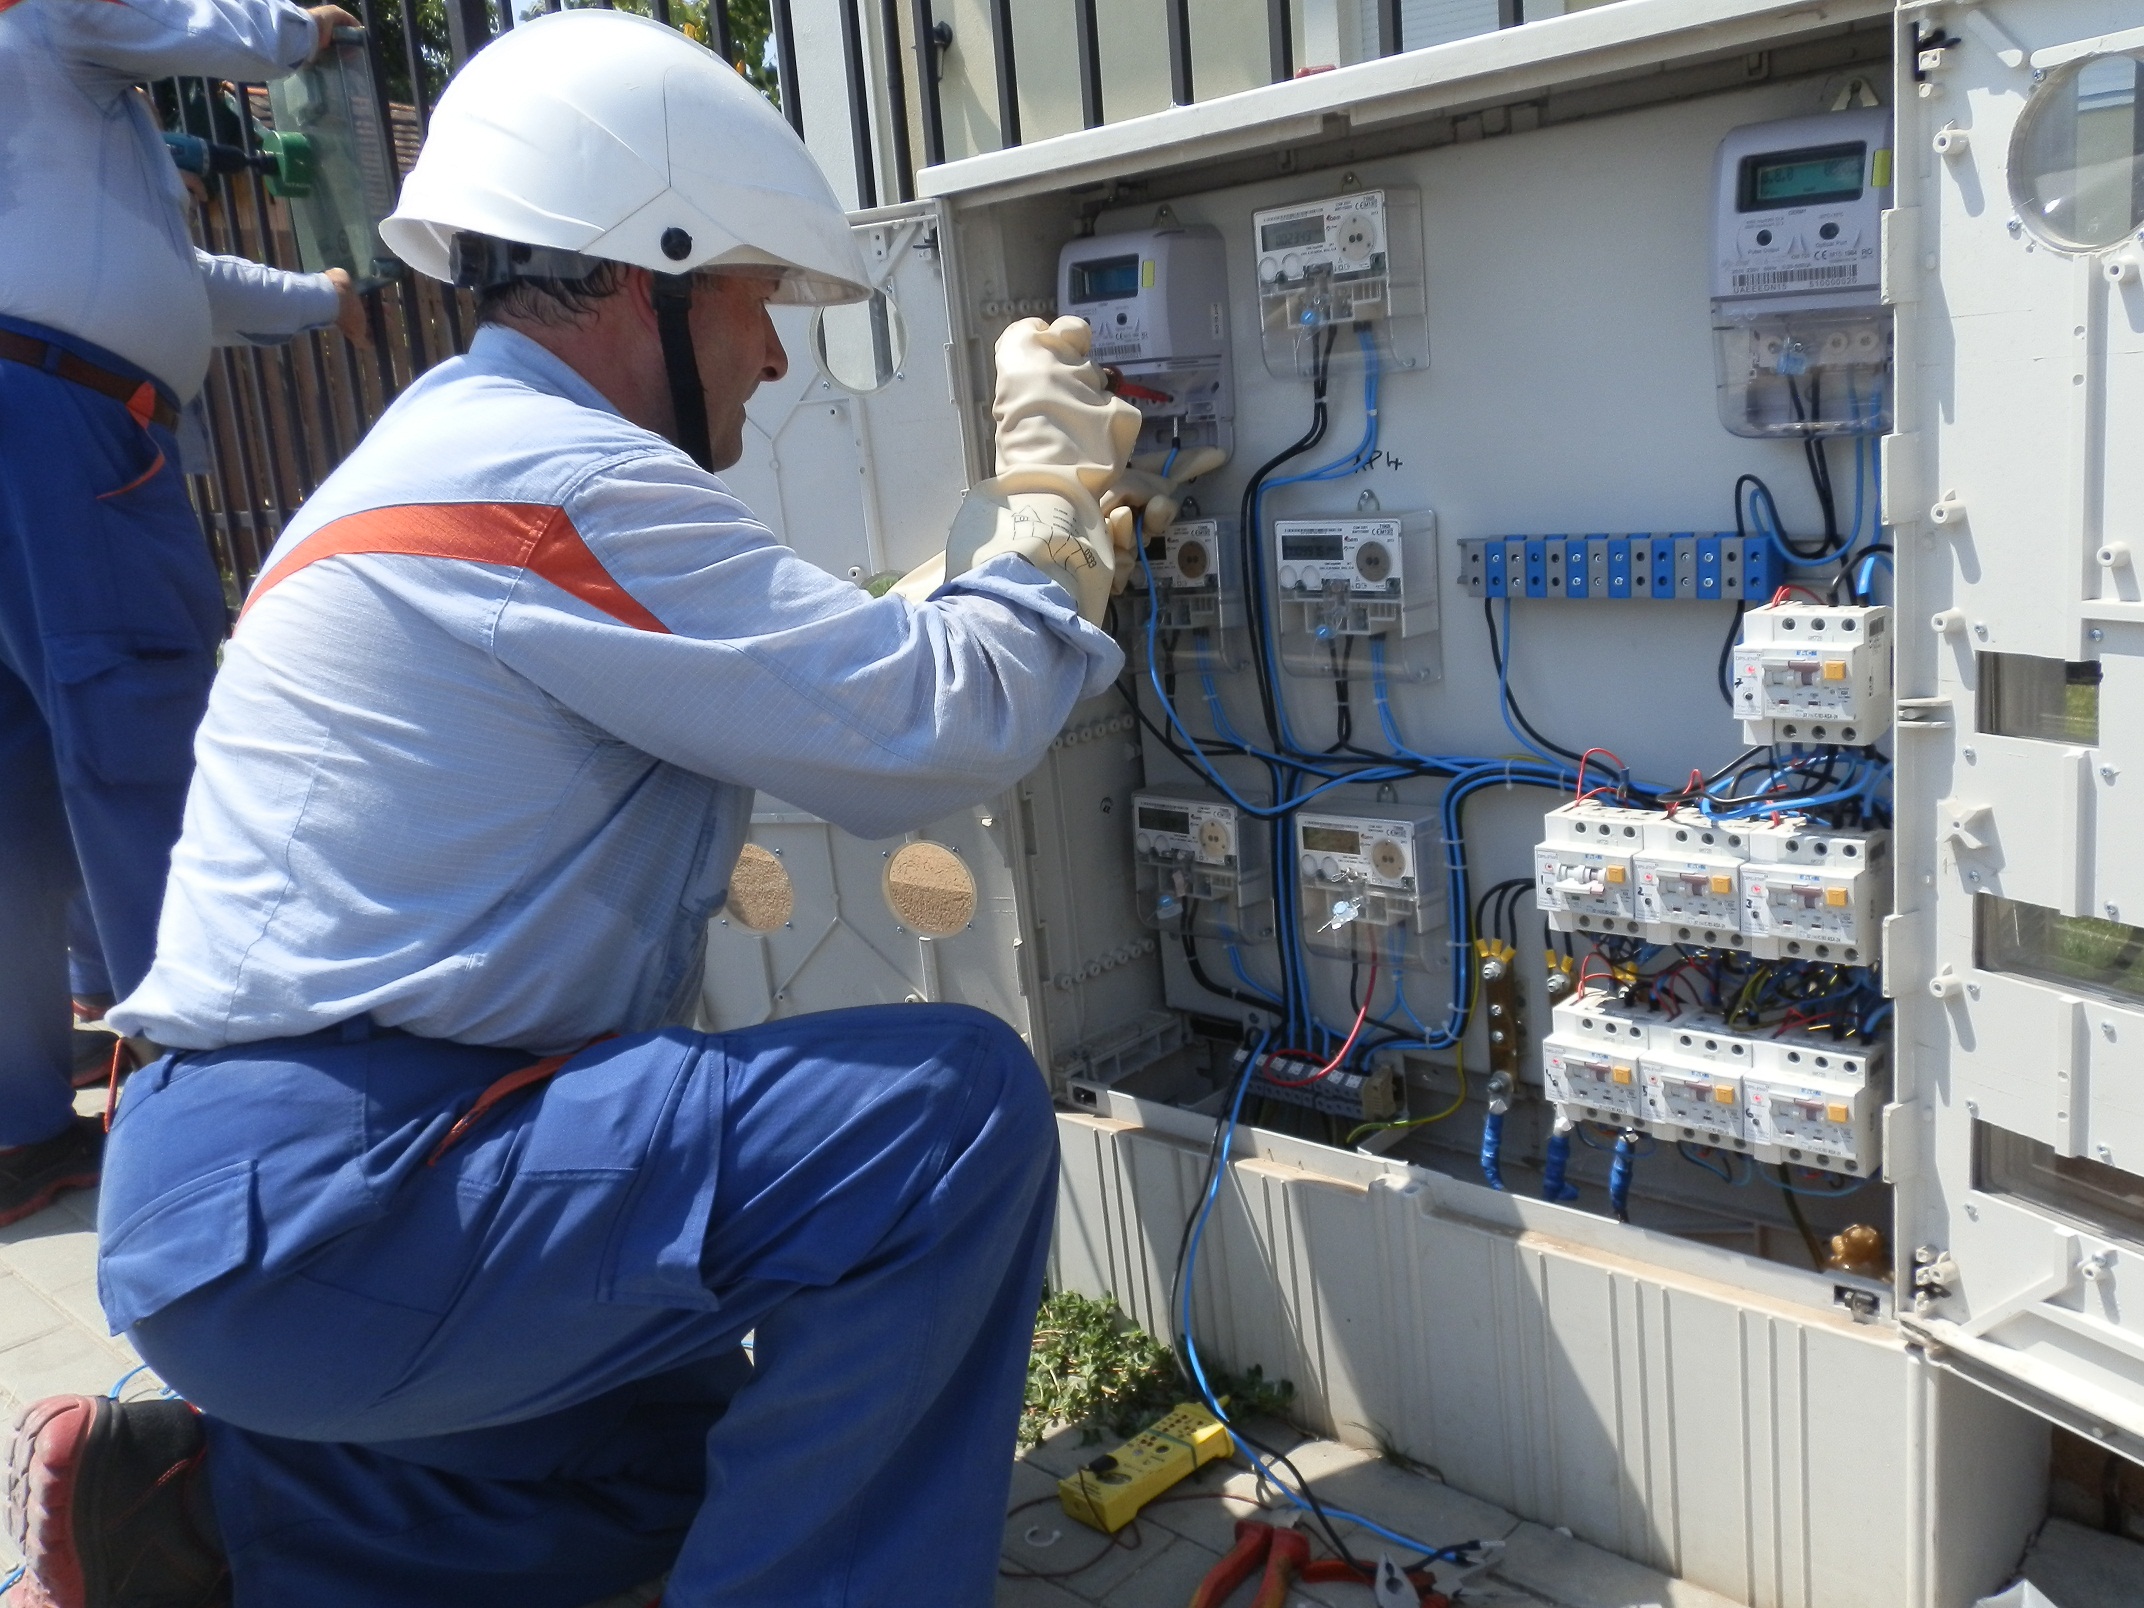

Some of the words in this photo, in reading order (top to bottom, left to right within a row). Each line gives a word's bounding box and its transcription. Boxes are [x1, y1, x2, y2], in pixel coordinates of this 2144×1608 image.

[1637, 886, 1644, 896] 2
[1746, 899, 1753, 909] 3
[1745, 1108, 1754, 1119] 6
